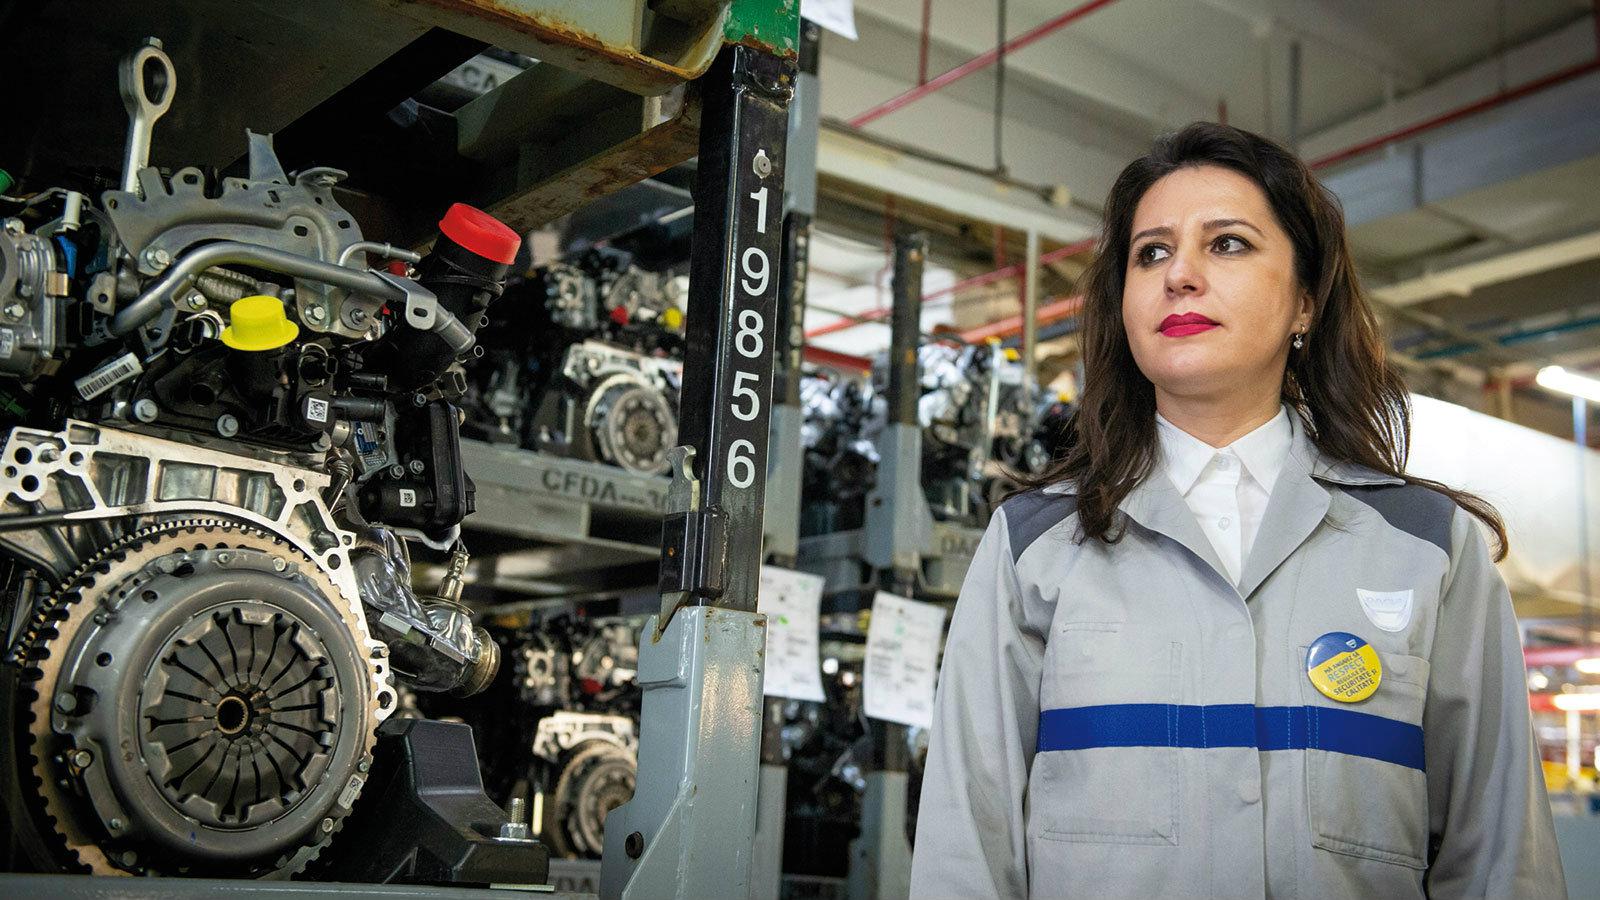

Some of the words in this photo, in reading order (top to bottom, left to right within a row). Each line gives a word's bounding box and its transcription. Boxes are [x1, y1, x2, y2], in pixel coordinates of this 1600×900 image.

[726, 187, 769, 489] 19856
[1328, 657, 1364, 682] RESPECT
[1333, 671, 1372, 696] SECURITATE
[1345, 679, 1374, 697] CALITATE
